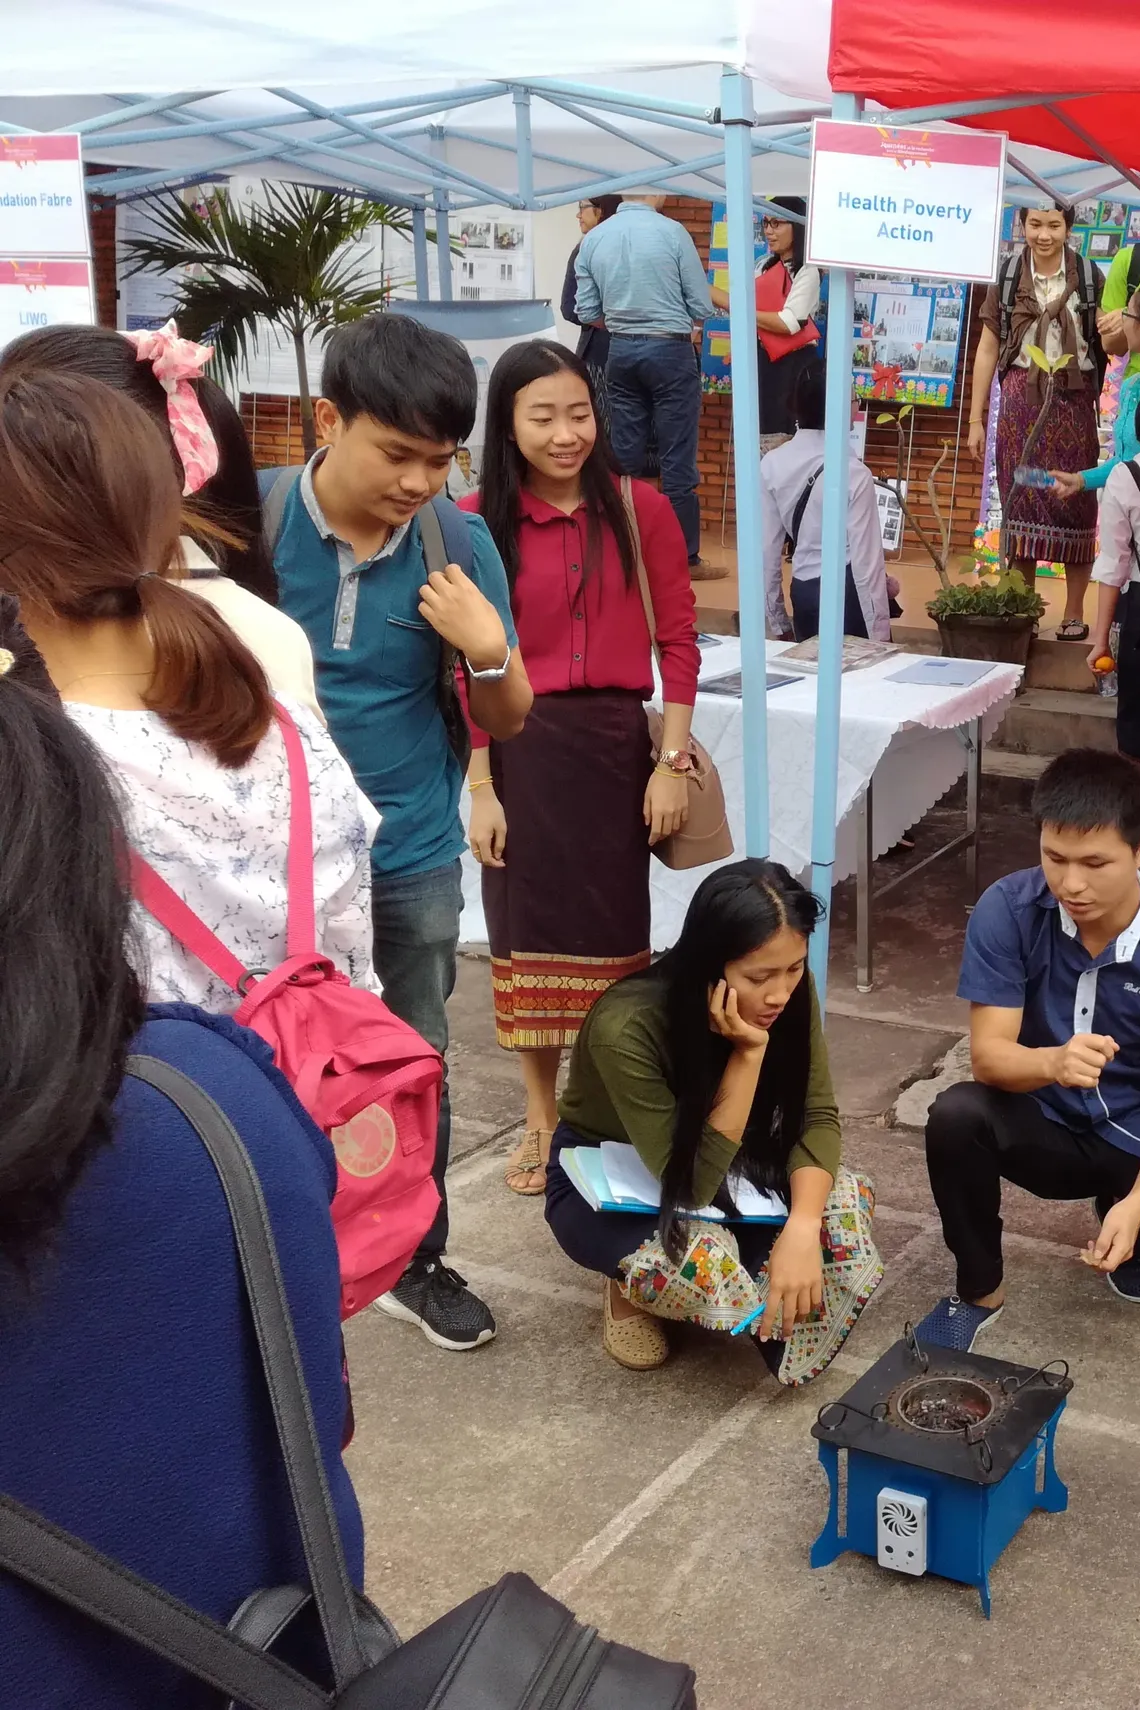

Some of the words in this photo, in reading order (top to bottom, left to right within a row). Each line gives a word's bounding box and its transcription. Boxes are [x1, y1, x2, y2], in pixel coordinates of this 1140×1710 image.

[0, 192, 37, 207] ndation
[40, 192, 73, 207] Fabre
[838, 191, 897, 213] Health
[903, 198, 972, 224] Poverty
[876, 221, 934, 243] Action
[19, 310, 48, 326] LIWG
